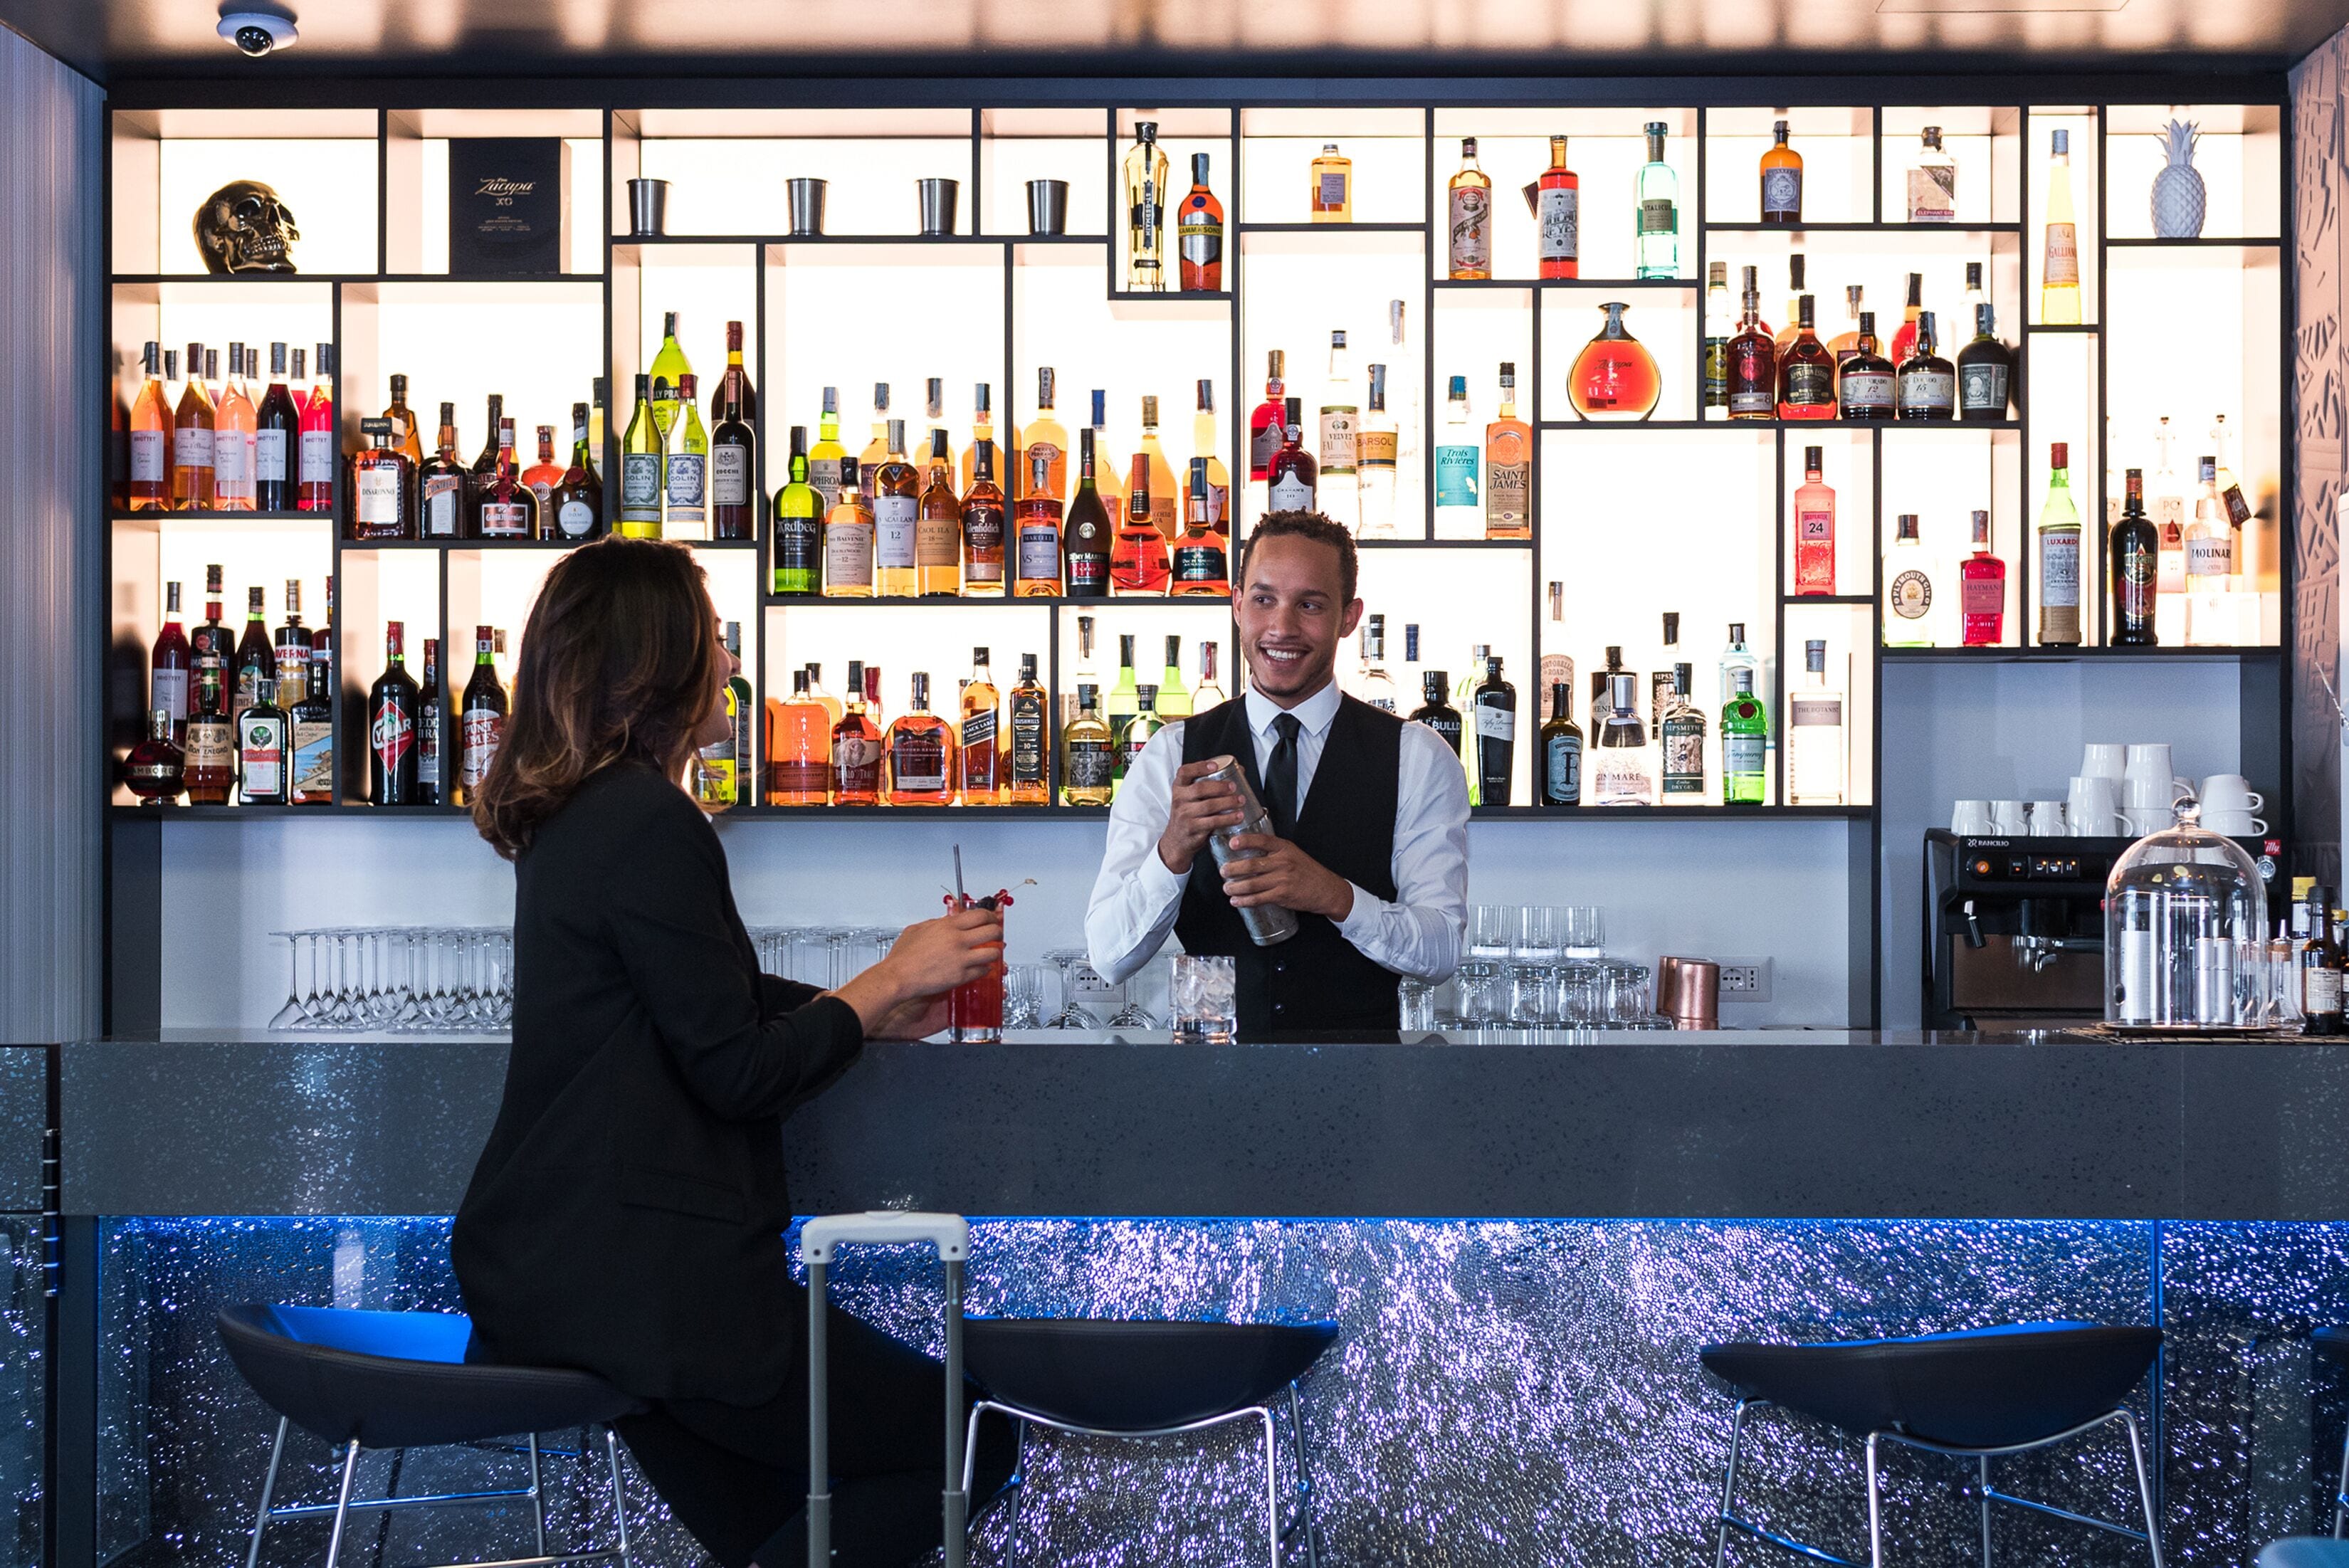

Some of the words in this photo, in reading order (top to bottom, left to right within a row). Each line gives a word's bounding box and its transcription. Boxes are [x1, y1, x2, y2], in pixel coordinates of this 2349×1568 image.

[475, 178, 536, 196] Zacapa
[664, 389, 679, 398] PRA
[1765, 394, 1770, 403] 8
[1357, 437, 1392, 447] BARSOL
[1493, 470, 1527, 480] SAINT
[1490, 480, 1527, 490] JAMES
[966, 522, 1000, 533] Glenfiddich
[1809, 522, 1824, 533] 24
[1021, 555, 1033, 564] VS
[1893, 572, 1925, 596] PLYMOUTH
[1542, 660, 1572, 672] ORTOBELLO
[464, 721, 493, 735] PUNT
[1432, 720, 1461, 730] BULLD
[470, 732, 499, 744] MES
[1560, 751, 1581, 785] F
[2265, 841, 2280, 853] illy
